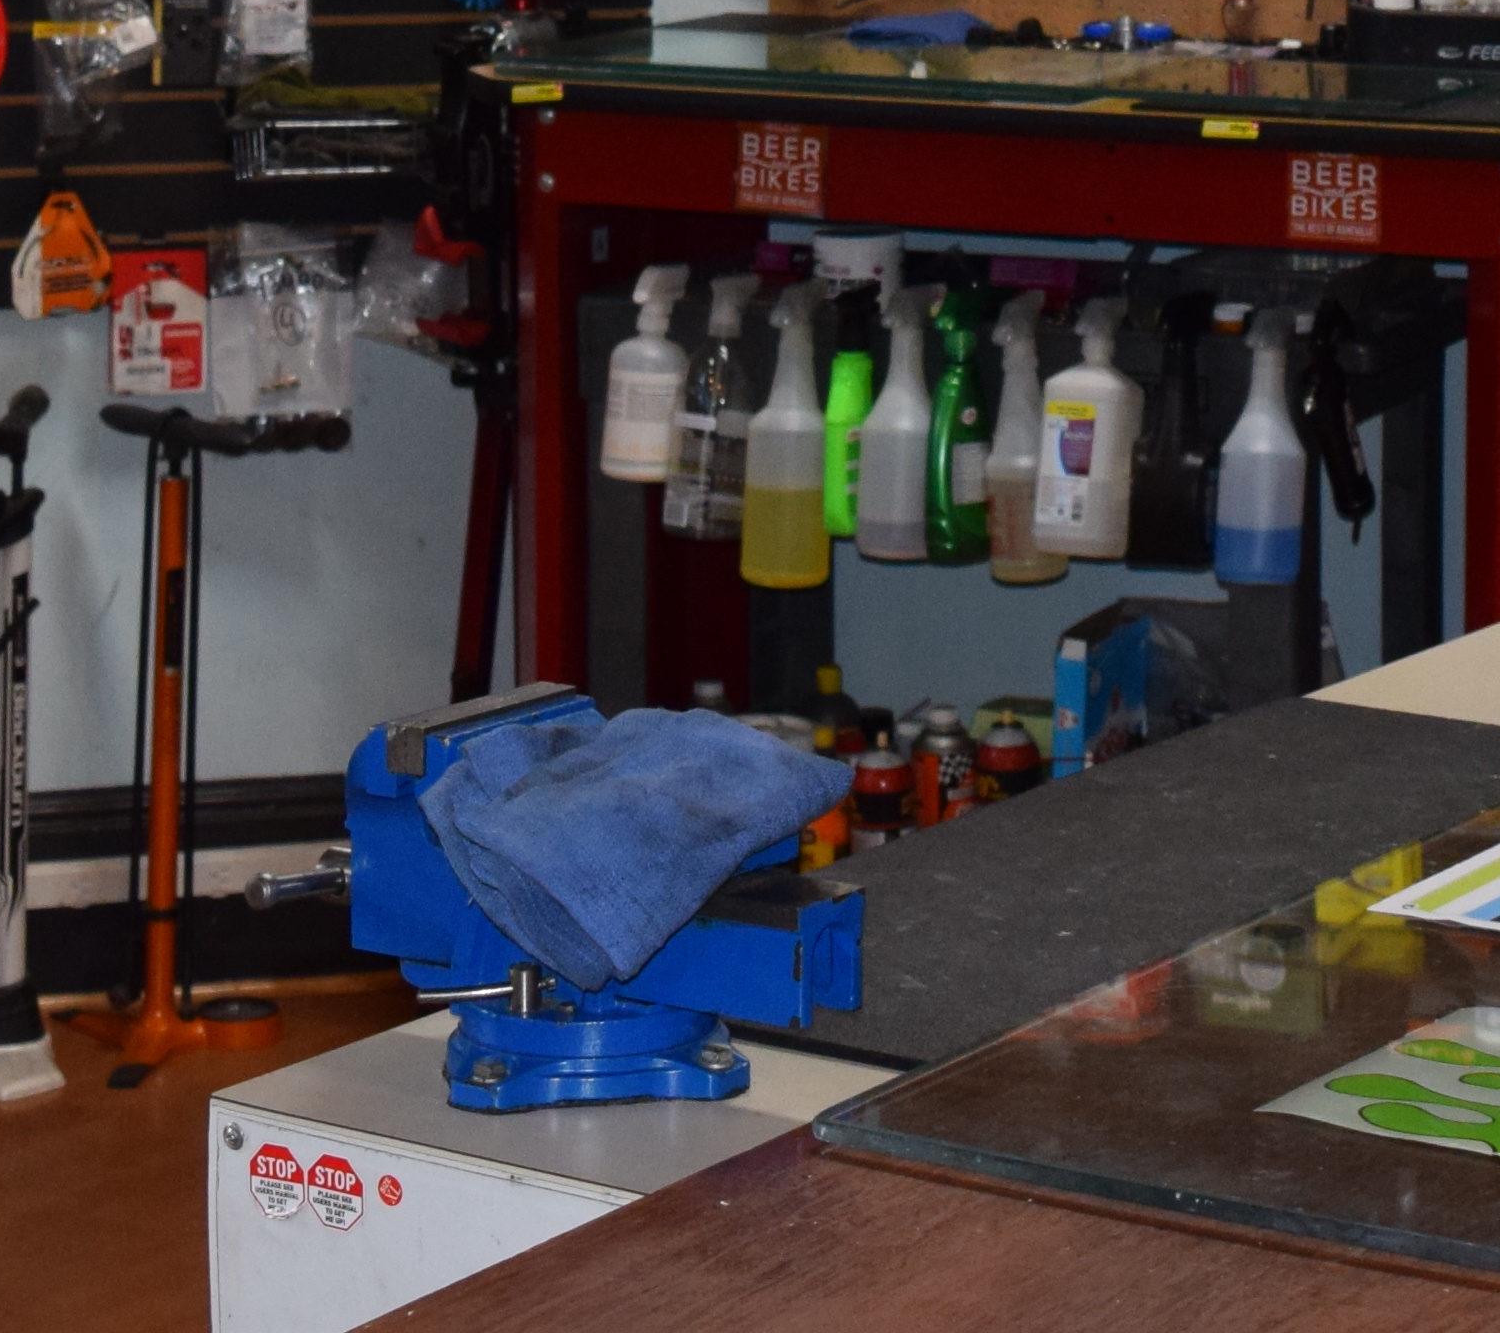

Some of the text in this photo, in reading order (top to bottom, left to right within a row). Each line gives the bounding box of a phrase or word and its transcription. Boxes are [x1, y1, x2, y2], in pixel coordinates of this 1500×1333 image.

[742, 132, 822, 163] BEER
[740, 168, 820, 194] BIKES
[1290, 158, 1377, 188] BEER
[1289, 196, 1377, 222] BIKES
[256, 1154, 298, 1181] STOP
[260, 1179, 295, 1192] PLEASE SEE
[314, 1165, 357, 1192] STOP
[255, 1186, 300, 1201] USERS MANUAL
[268, 1196, 288, 1206] TO SET
[318, 1190, 353, 1204] PLEASE SEE
[312, 1197, 358, 1213] USERS MANUAL
[326, 1207, 346, 1217] TO SET
[325, 1215, 334, 1224] ME
